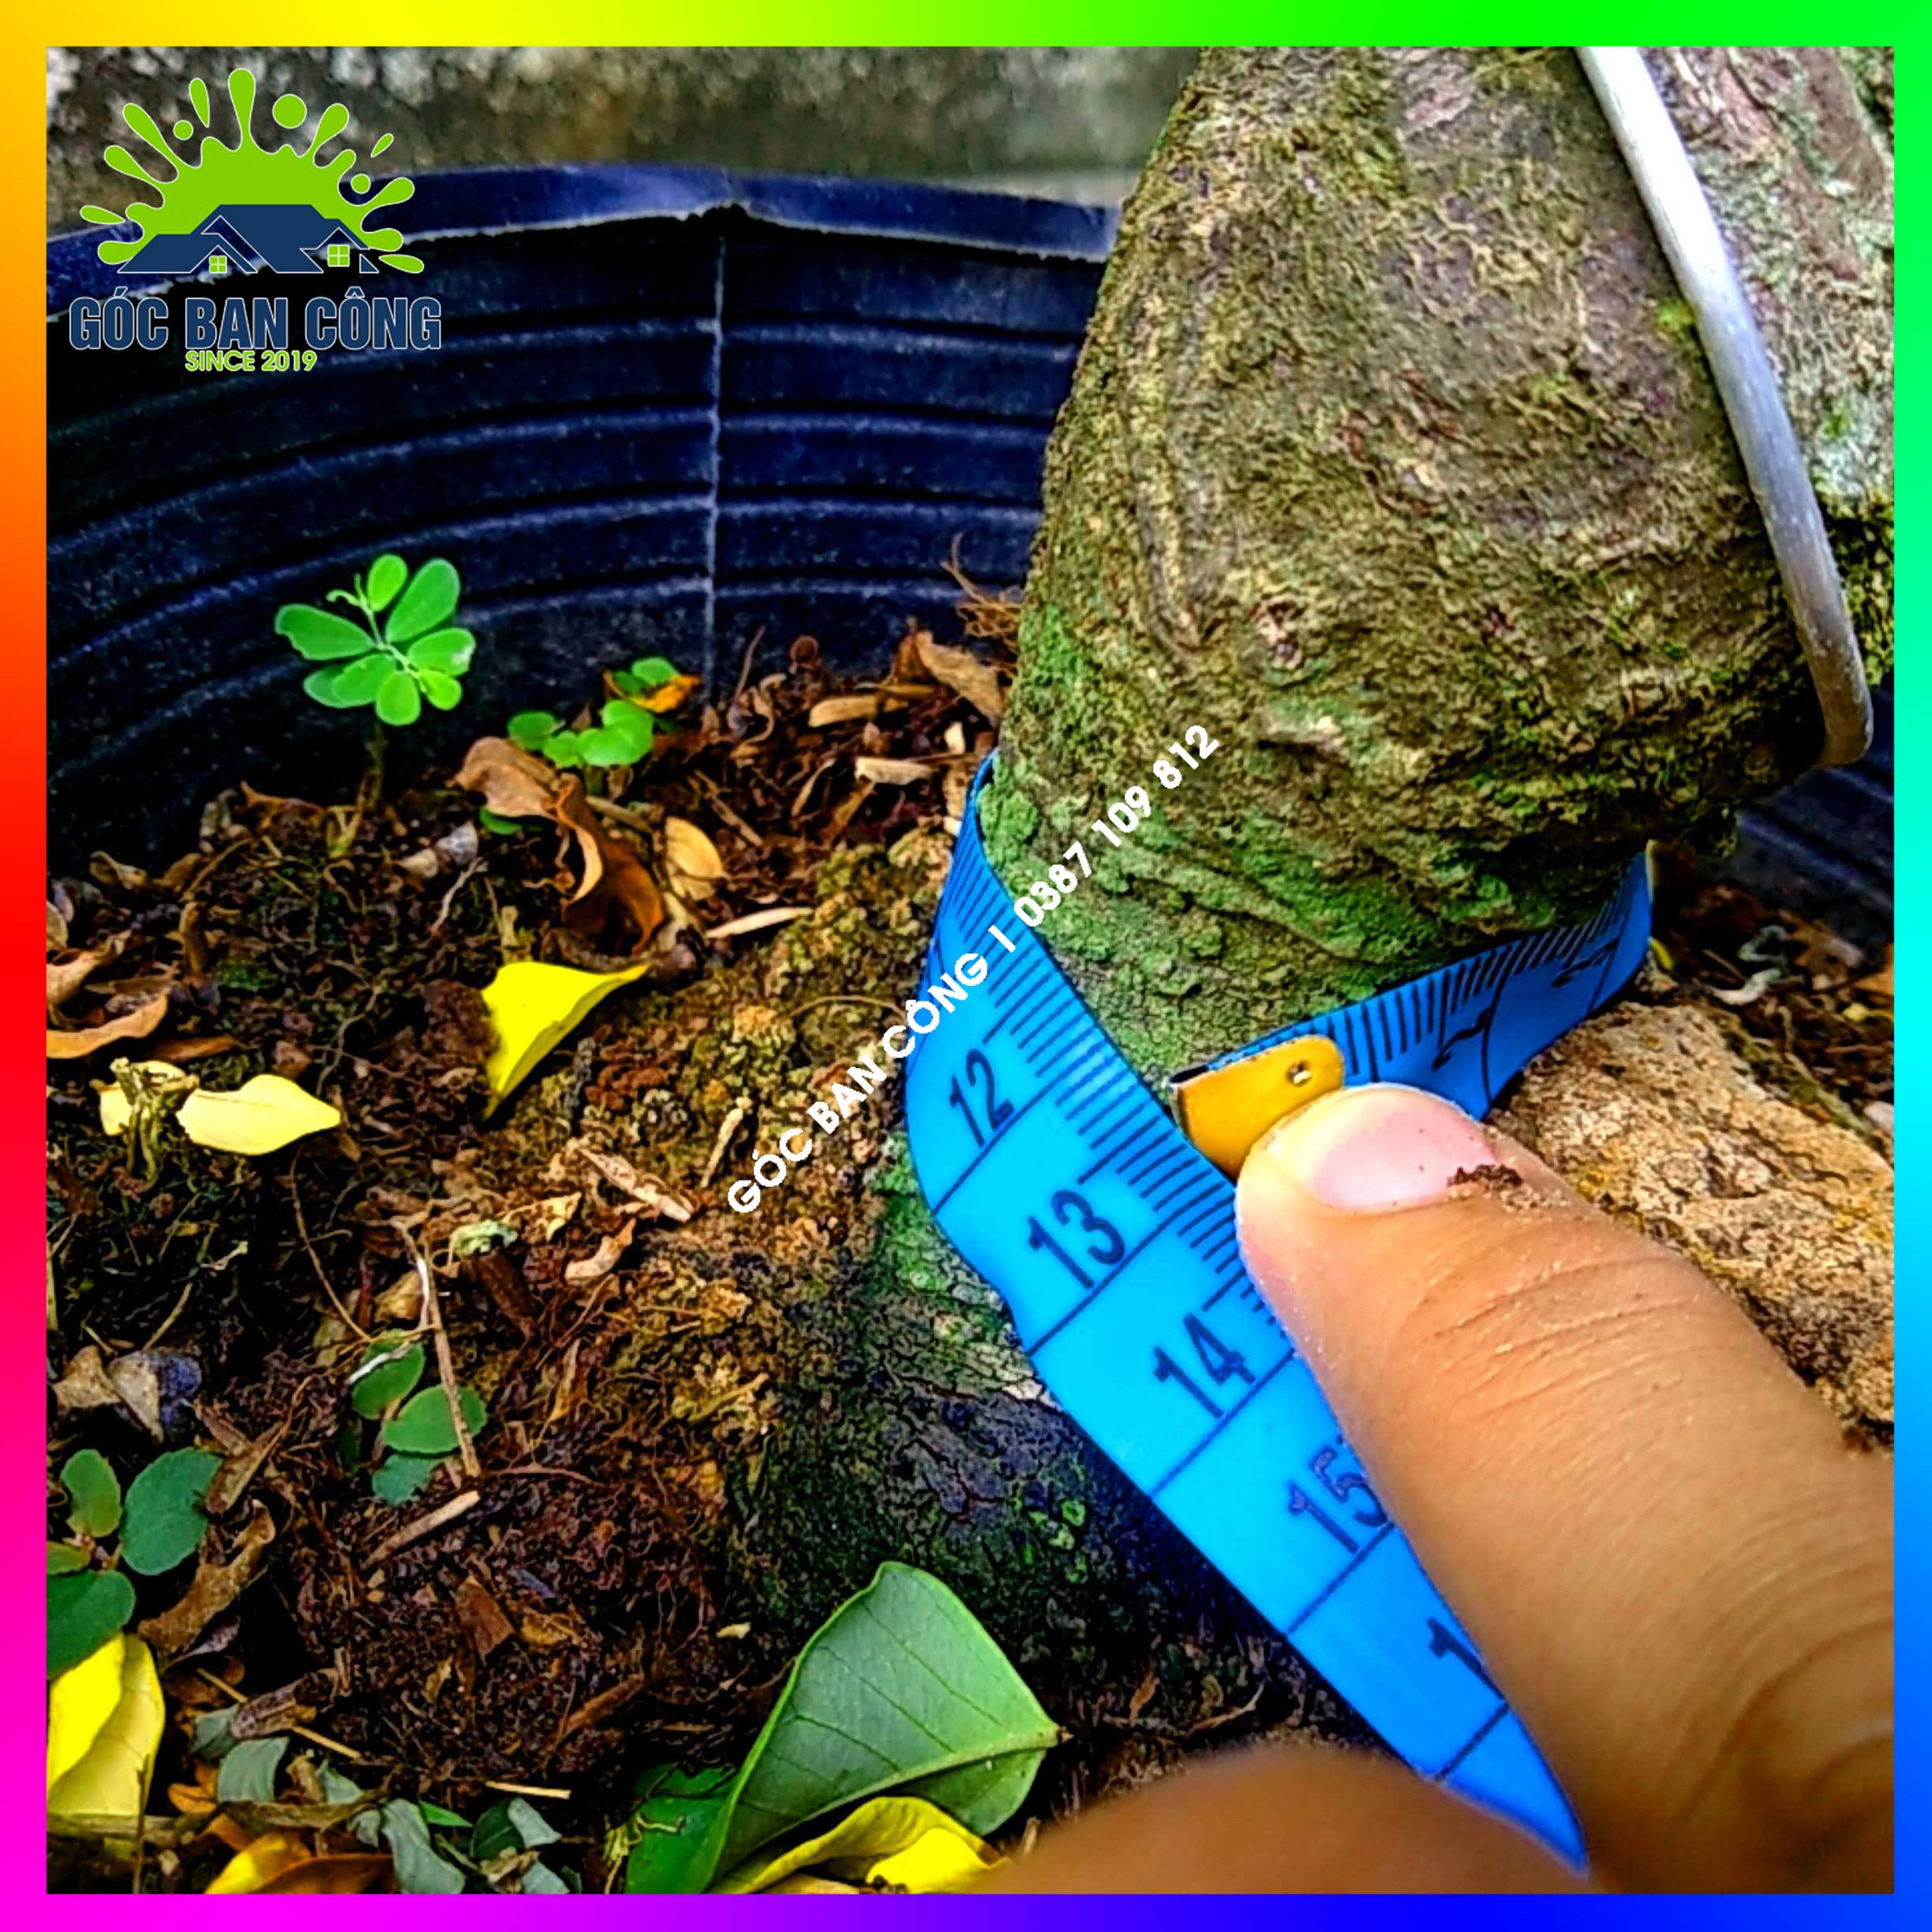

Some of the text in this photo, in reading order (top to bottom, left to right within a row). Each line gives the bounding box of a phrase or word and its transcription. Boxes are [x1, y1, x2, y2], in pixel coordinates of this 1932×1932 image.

[949, 1048, 1015, 1147] 12
[1028, 1190, 1125, 1290] 13
[1154, 1313, 1256, 1418] 14
[1288, 1447, 1390, 1554] 15
[1427, 1616, 1506, 1700] 1
